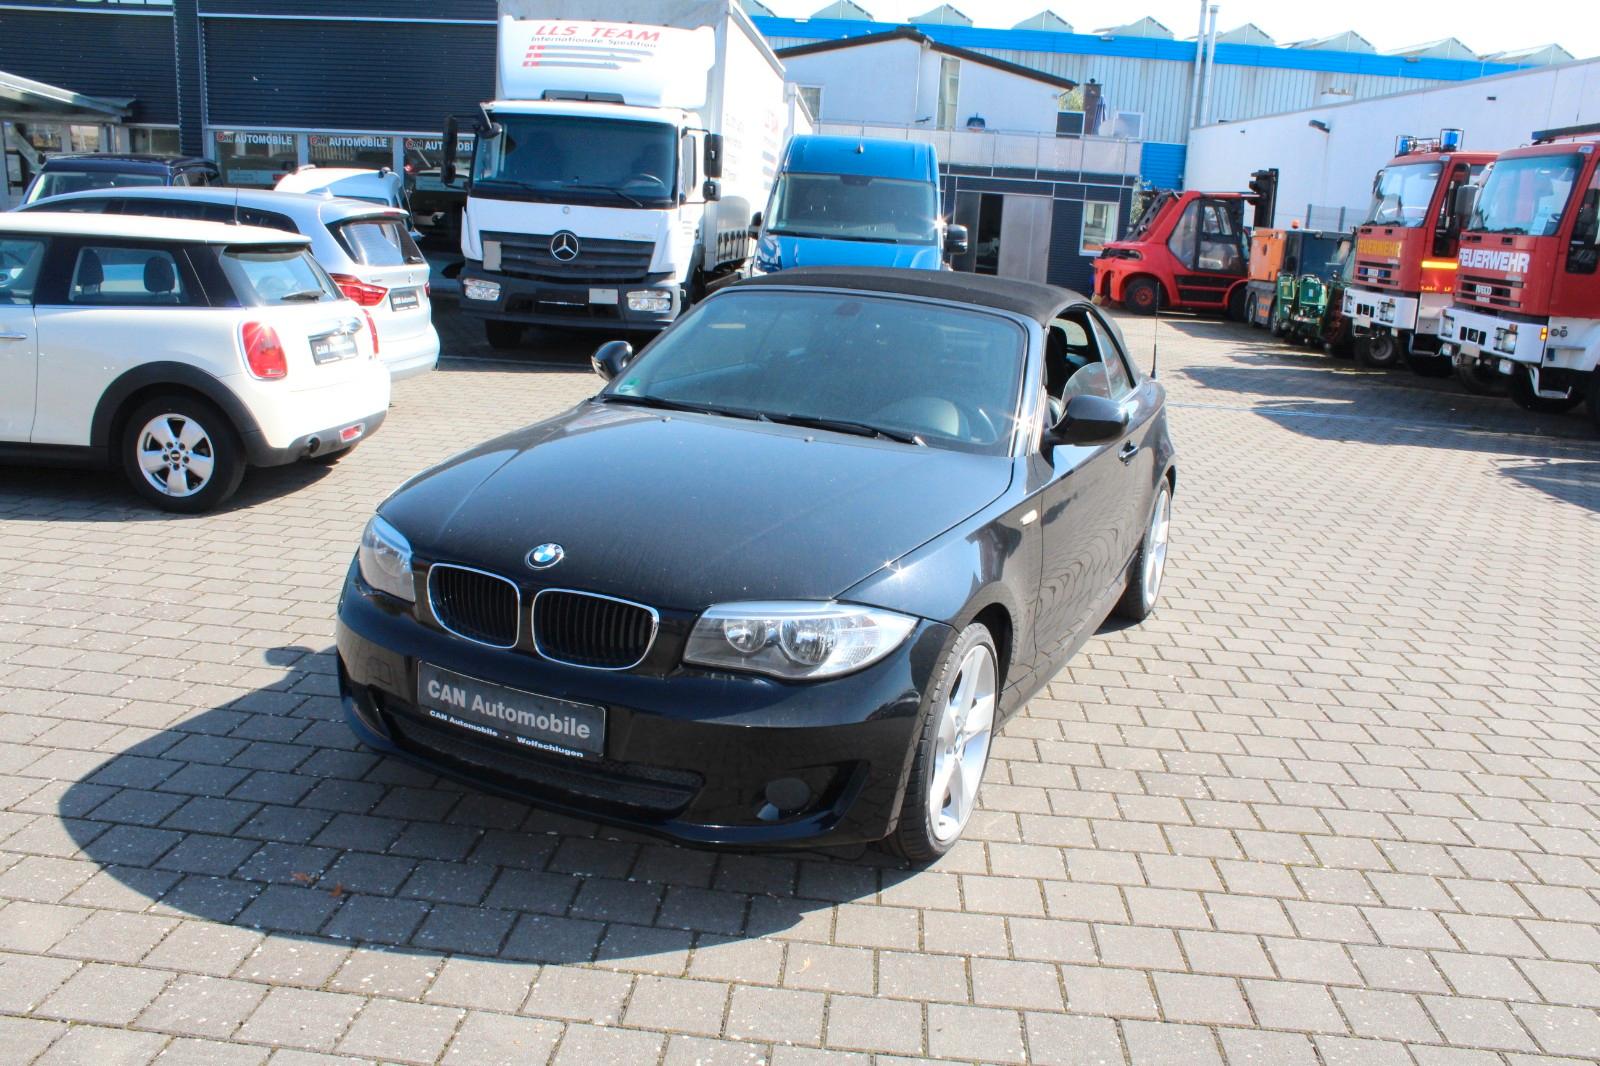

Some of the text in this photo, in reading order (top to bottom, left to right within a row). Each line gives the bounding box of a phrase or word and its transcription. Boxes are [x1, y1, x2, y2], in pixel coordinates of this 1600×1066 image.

[530, 36, 604, 44] Internationale
[535, 25, 660, 41] LLS TEAM
[1459, 247, 1531, 274] FEUERWEHR
[428, 680, 591, 738] CAN Automobile
[429, 710, 584, 758] CAN Automobile Wolfschlugen
